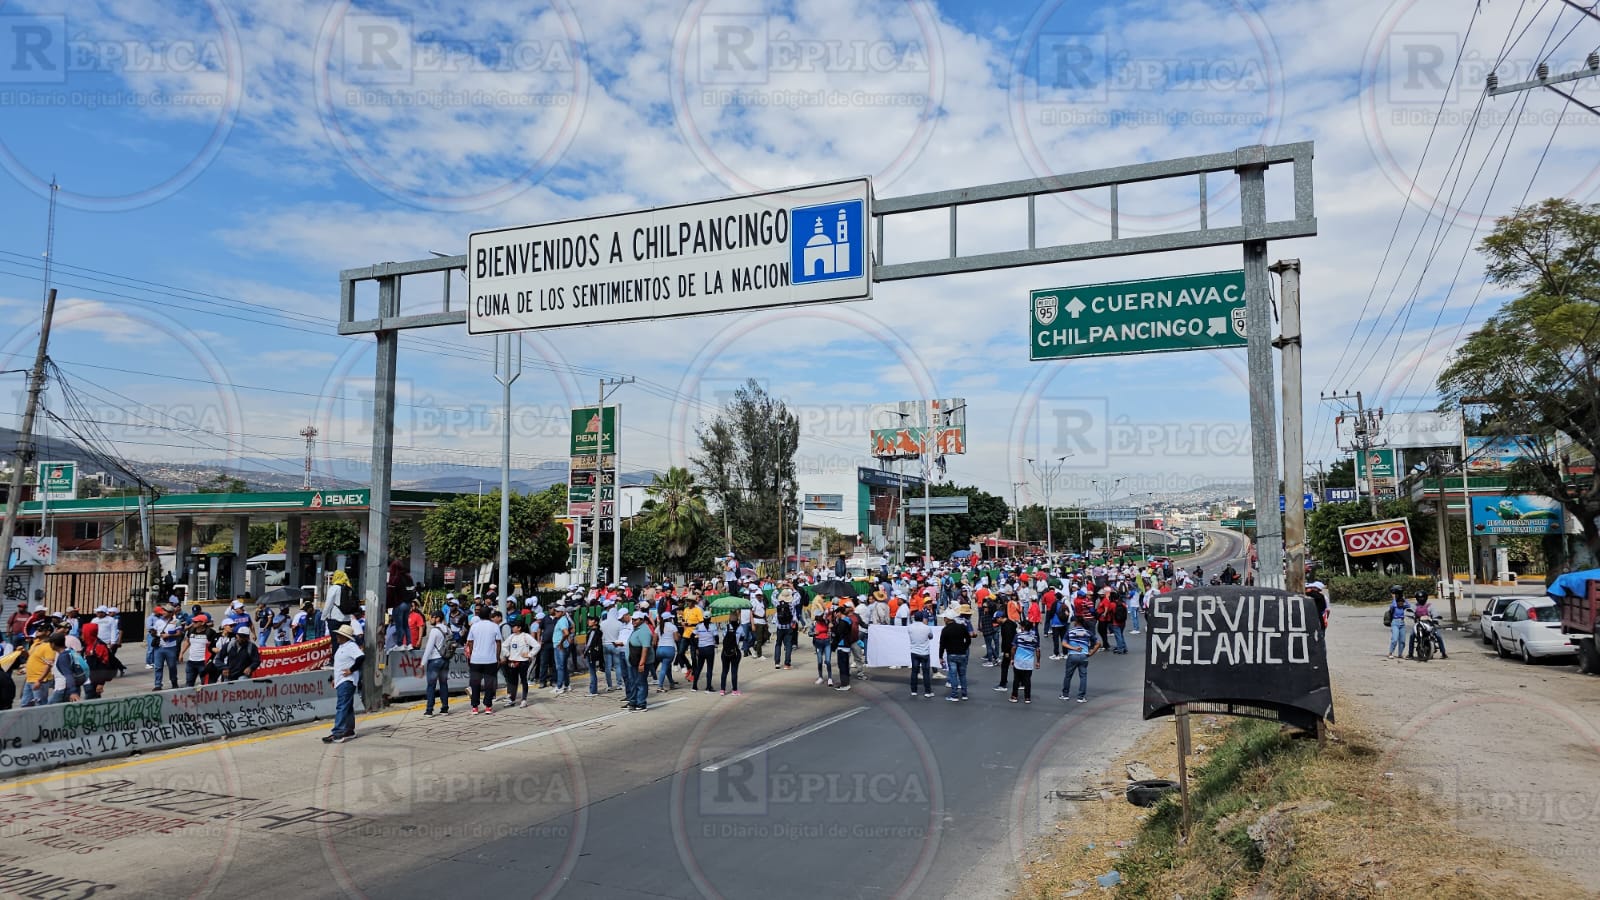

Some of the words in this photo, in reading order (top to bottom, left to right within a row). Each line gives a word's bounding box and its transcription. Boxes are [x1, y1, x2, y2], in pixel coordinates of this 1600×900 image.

[477, 233, 600, 279] BIENVENIDOS
[609, 231, 623, 264] A
[633, 208, 788, 262] CHILPANCINGO
[476, 294, 510, 318] CUNA
[517, 291, 533, 313] DE
[540, 287, 565, 310] LOS
[572, 276, 671, 308] SENTIMIENTOS
[679, 273, 697, 298] DE
[704, 270, 724, 296] LA
[732, 262, 789, 291] NACION
[1039, 307, 1053, 319] 95
[1037, 317, 1204, 347] CHILPANCINGO
[1237, 320, 1245, 332] 9
[576, 433, 610, 443] PEMX
[325, 494, 364, 507] PEMEX
[591, 489, 613, 499] 2.74
[591, 504, 613, 515] 2.74
[590, 520, 613, 531] 2.13
[1349, 528, 1405, 552] OXXO
[1154, 595, 1308, 633] SERVICIO
[1151, 628, 1310, 666] MECANICO
[98, 733, 118, 753] 12
[122, 732, 138, 747] DE
